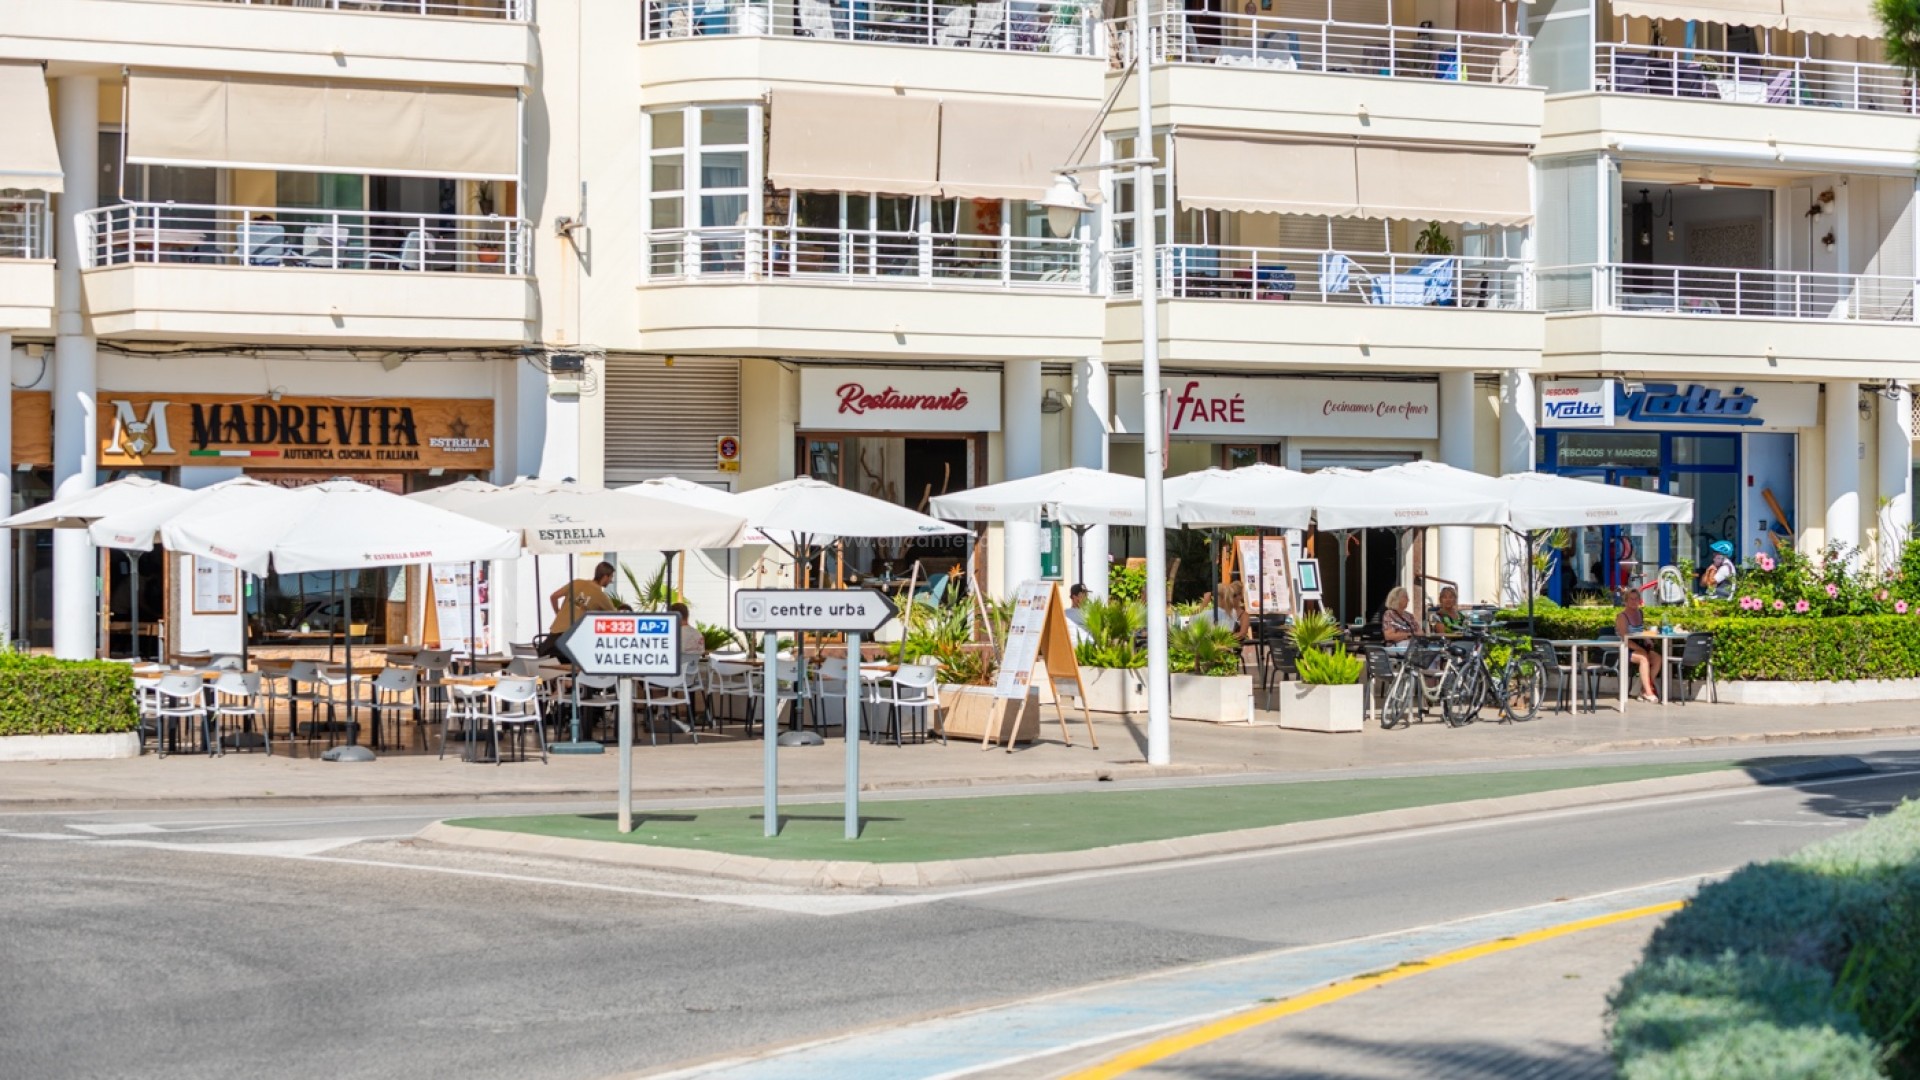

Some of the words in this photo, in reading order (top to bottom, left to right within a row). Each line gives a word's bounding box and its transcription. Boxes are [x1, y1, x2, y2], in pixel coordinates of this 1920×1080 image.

[1546, 387, 1579, 396] PESCADOS
[836, 383, 969, 415] Restaurante
[1323, 399, 1374, 416] Cocinamos
[1377, 401, 1396, 417] Con
[1399, 401, 1429, 420] Amor
[189, 403, 421, 450] MADREVITA
[429, 437, 491, 448] ESTRELLA
[283, 449, 334, 460] AUTENTICA
[338, 449, 371, 460] CUCINA
[376, 450, 420, 461] ITALIANA
[1560, 448, 1604, 458] PESCADOS
[1607, 448, 1614, 458] Y
[1615, 448, 1658, 458] MARISCOS
[539, 528, 605, 541] ESTRELLA
[770, 603, 823, 616] centre
[596, 621, 633, 632] N-332
[640, 621, 667, 632] AP-7
[595, 637, 669, 649] ALICANTE
[595, 653, 669, 665] VALENCIA
